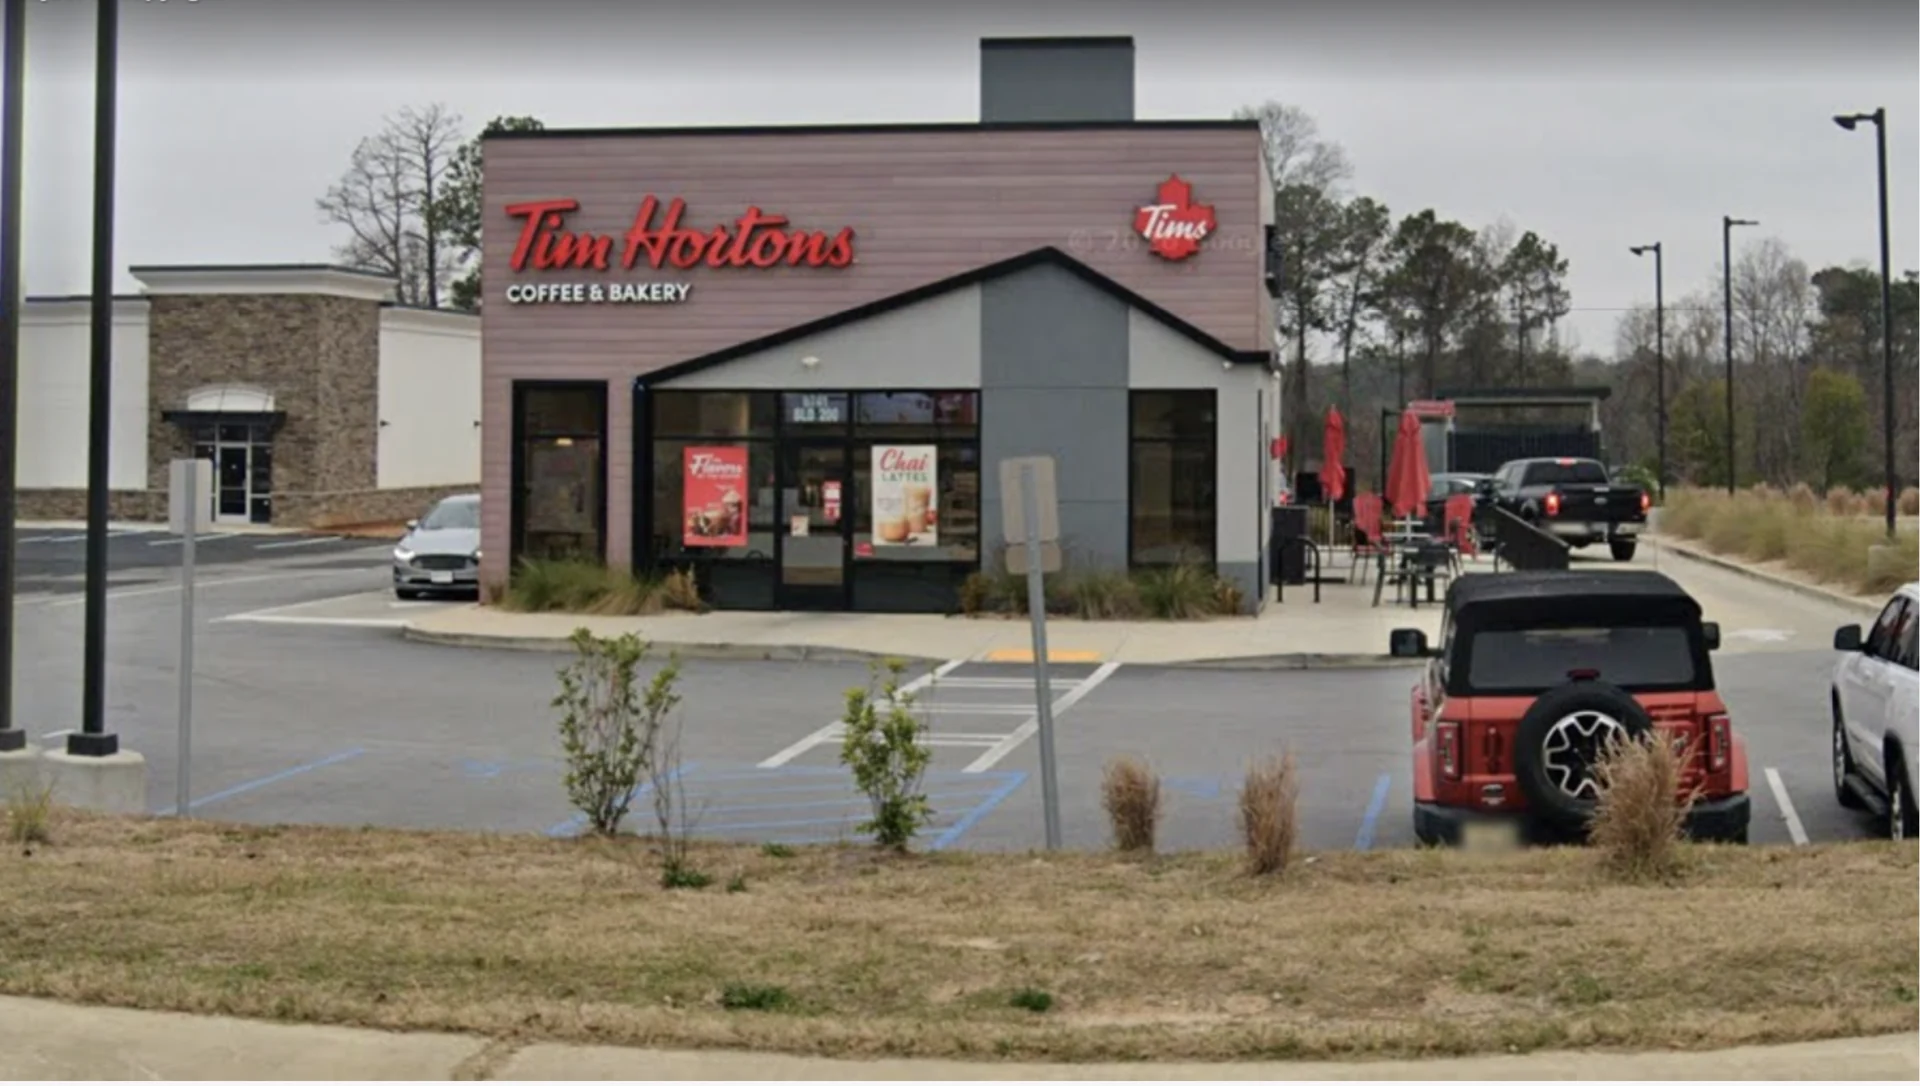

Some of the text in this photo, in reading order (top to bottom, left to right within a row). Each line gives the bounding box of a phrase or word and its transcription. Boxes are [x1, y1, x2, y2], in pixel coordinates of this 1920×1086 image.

[505, 193, 855, 272] Tim Hortons
[1139, 203, 1209, 242] Tims
[506, 283, 691, 303] COFFEE & BAKERY
[880, 447, 929, 472] Chai
[881, 472, 928, 483] LATTES
